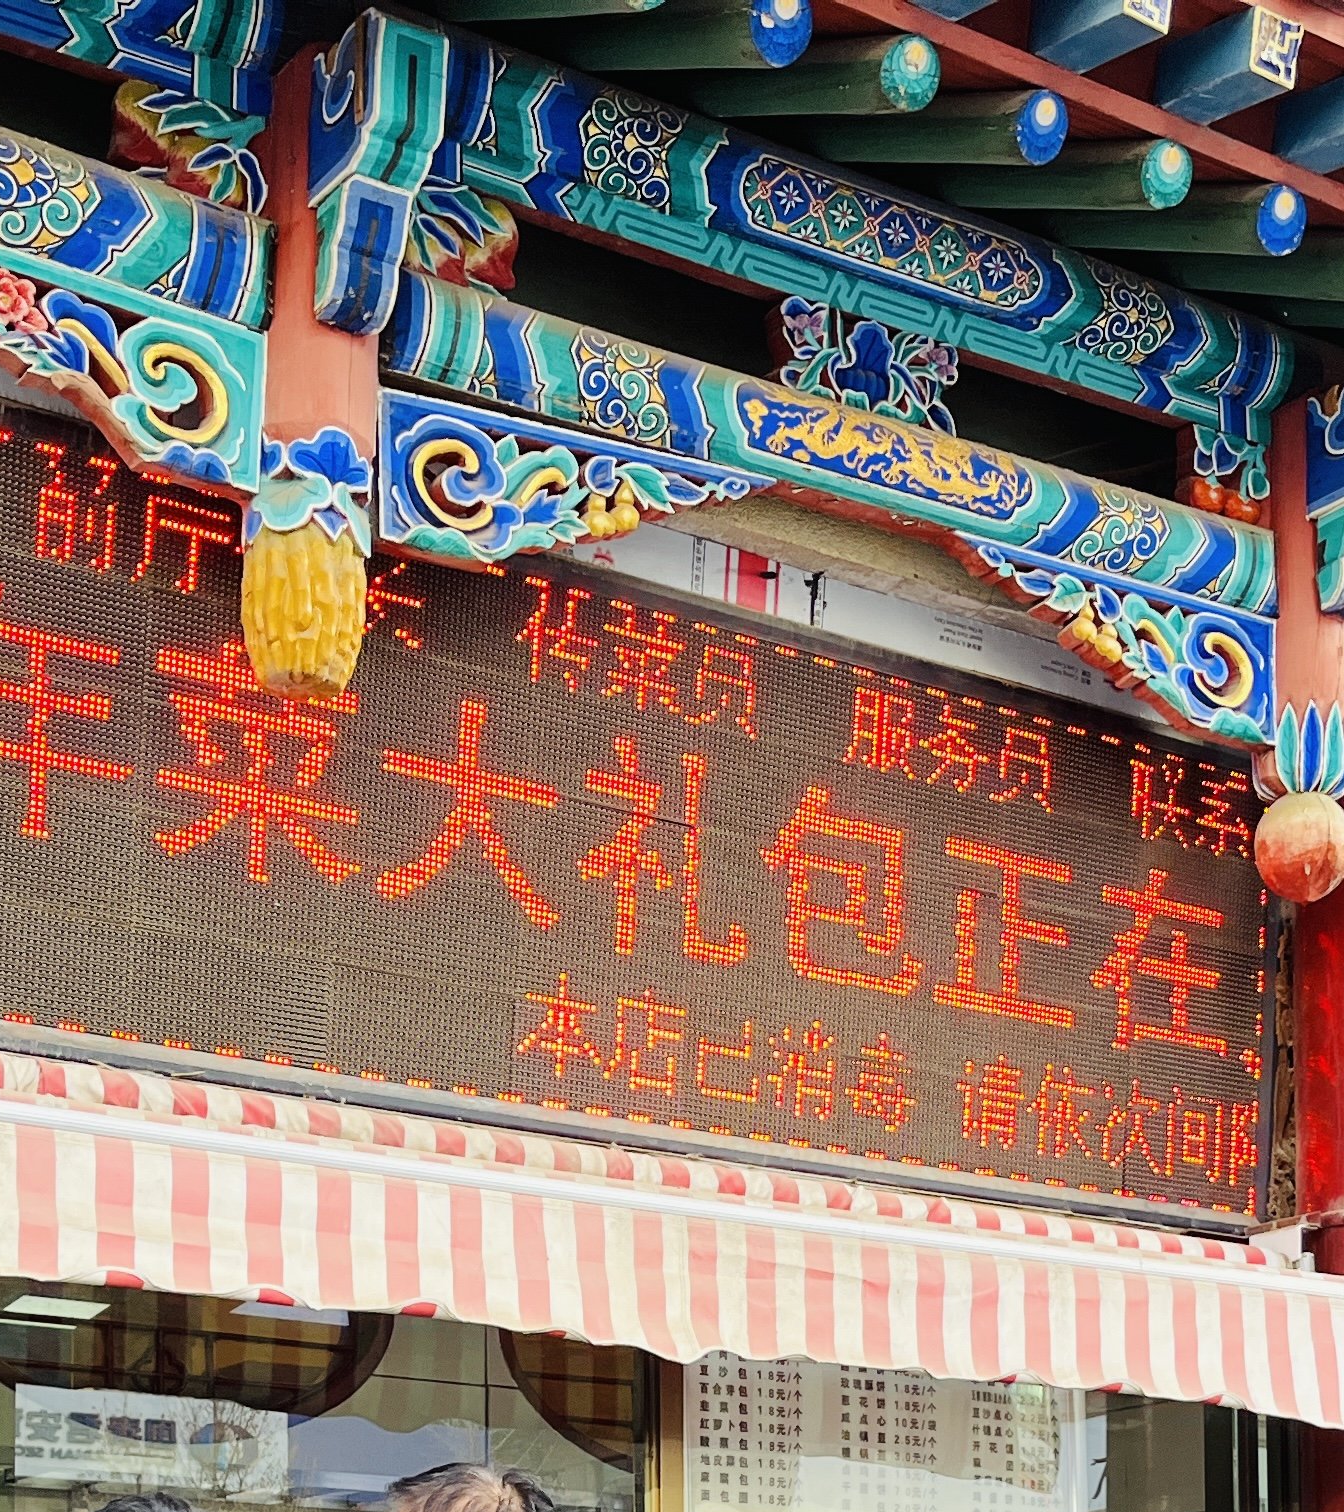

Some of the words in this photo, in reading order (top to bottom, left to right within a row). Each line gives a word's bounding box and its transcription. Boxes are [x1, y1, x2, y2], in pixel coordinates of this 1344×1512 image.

[844, 686, 1054, 812] 服务员
[517, 971, 919, 1133] 本店已消毒
